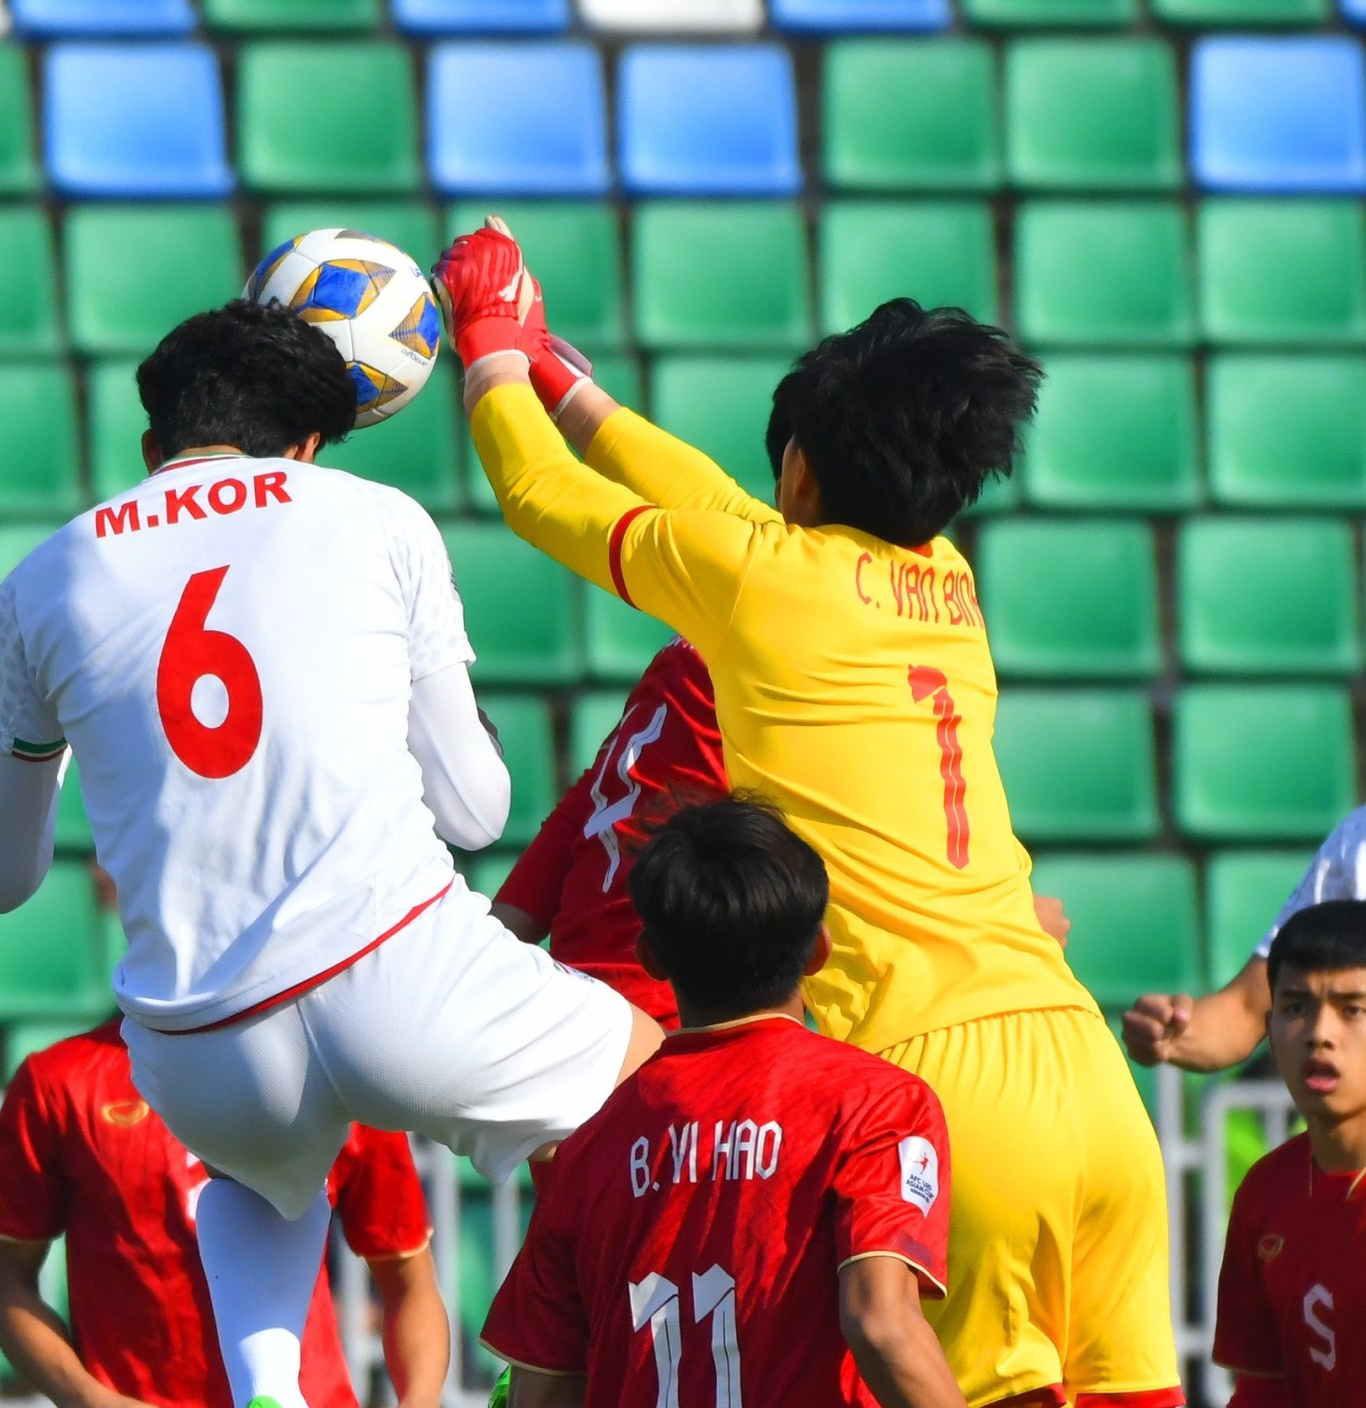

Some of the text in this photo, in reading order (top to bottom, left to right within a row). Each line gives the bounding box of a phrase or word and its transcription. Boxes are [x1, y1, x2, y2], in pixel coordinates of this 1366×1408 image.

[95, 471, 292, 538] M.KOR
[856, 552, 881, 609] C.
[890, 560, 939, 624] VAN
[156, 565, 263, 779] 6
[908, 664, 970, 870] 1
[630, 1136, 661, 1198] B.
[711, 1118, 783, 1180] HAO
